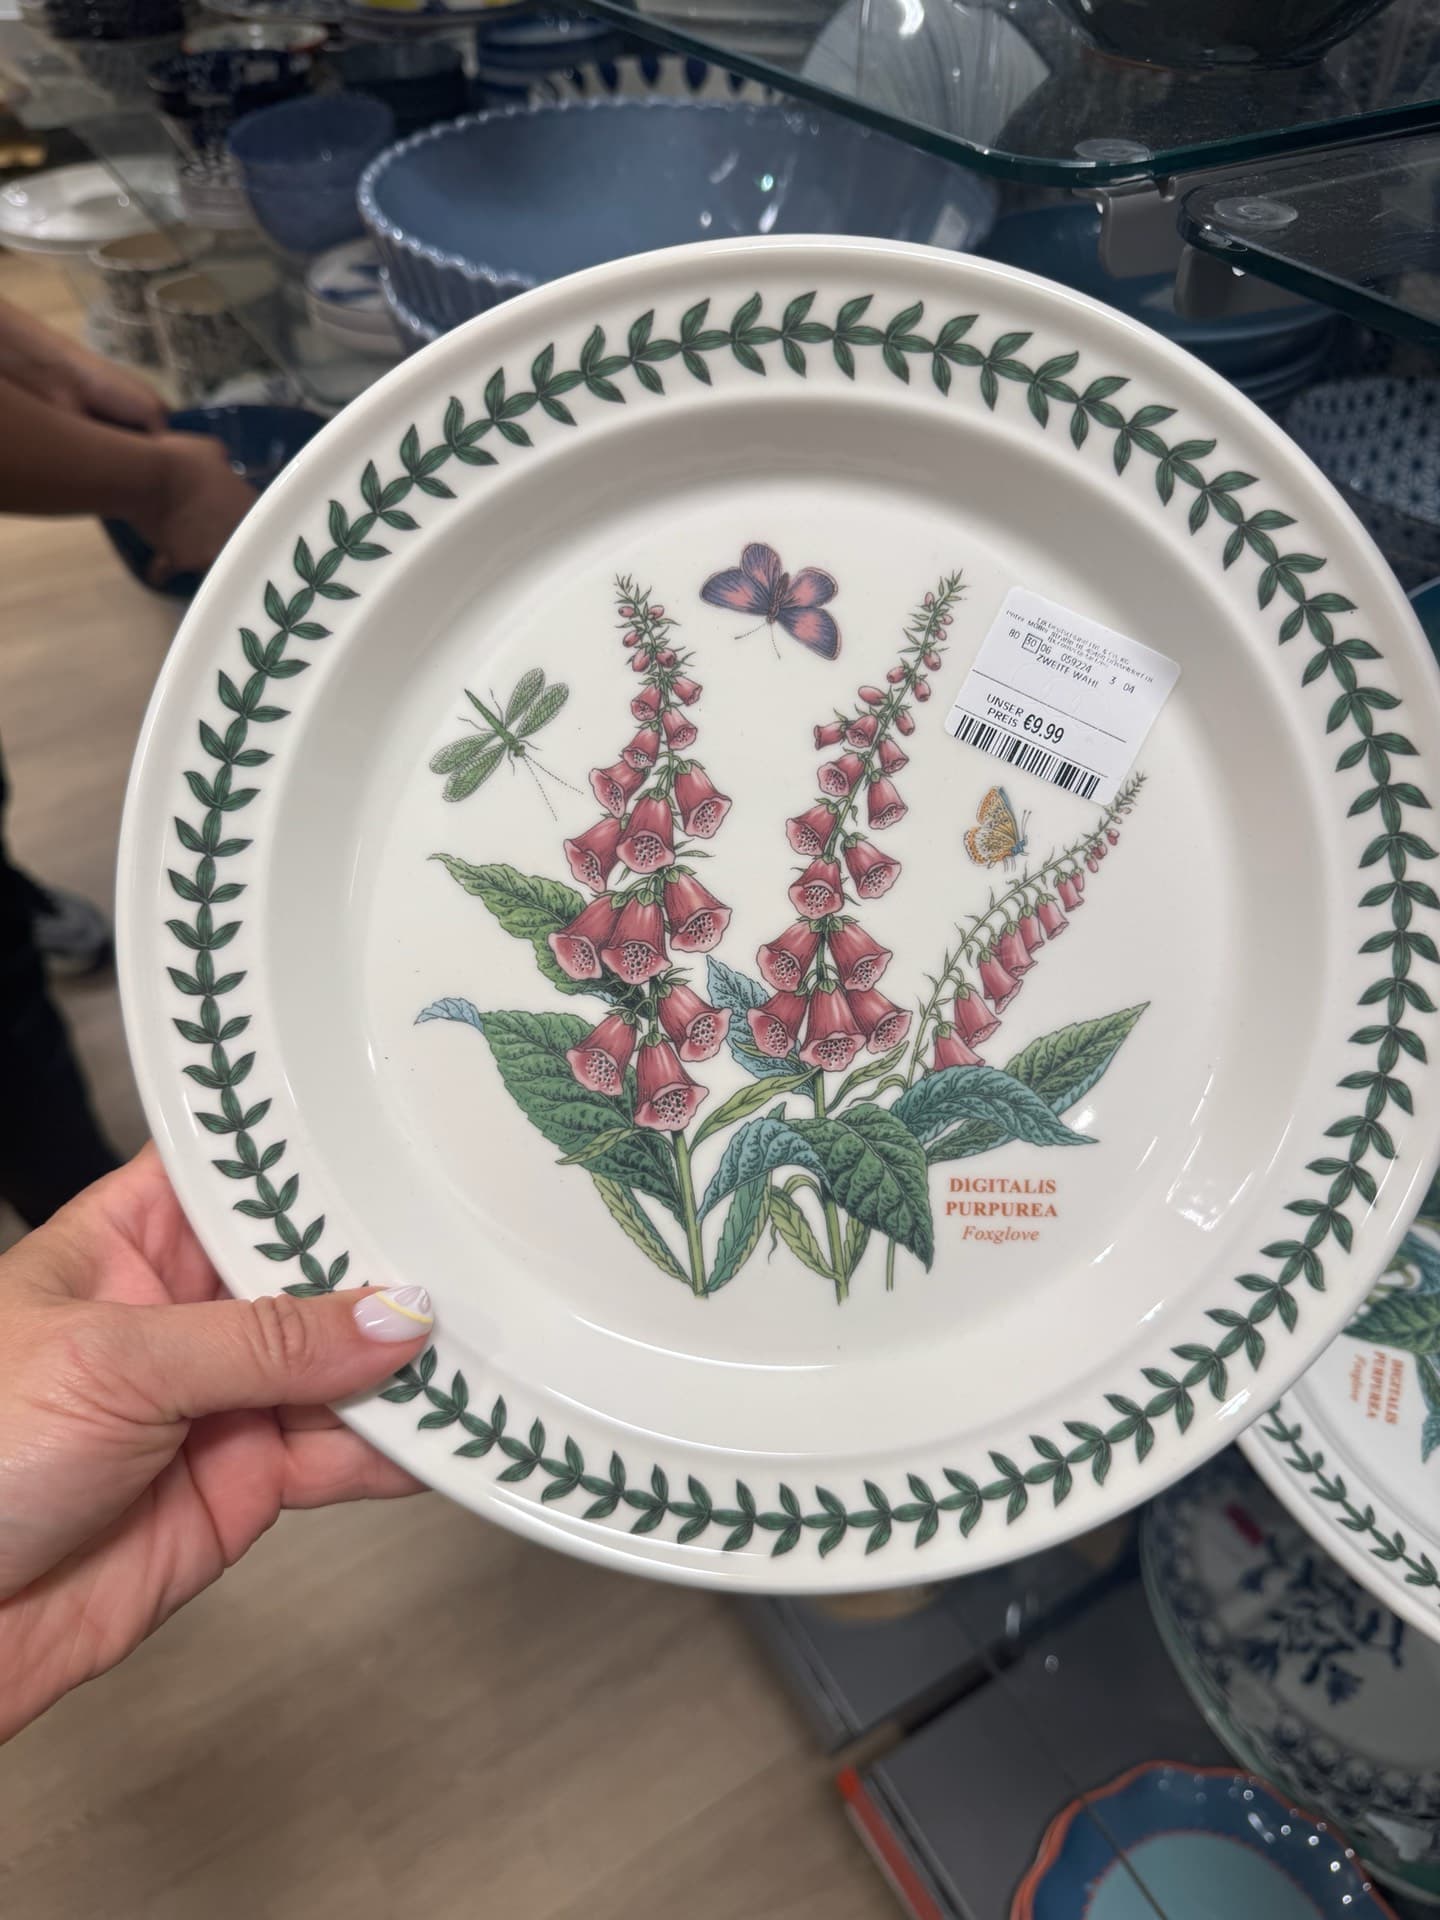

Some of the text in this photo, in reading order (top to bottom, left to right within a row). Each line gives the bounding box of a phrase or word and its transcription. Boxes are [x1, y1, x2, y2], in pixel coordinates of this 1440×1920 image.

[1060, 653, 1092, 674] 059224
[1109, 676, 1117, 685] 3
[1122, 682, 1135, 694] 04
[986, 693, 1025, 718] UNSER
[987, 707, 1065, 744] PREIS €9.99
[949, 1176, 1057, 1194] DIGITALIS
[945, 1201, 1058, 1218] PURPUREA
[961, 1225, 1040, 1244] Foxglove
